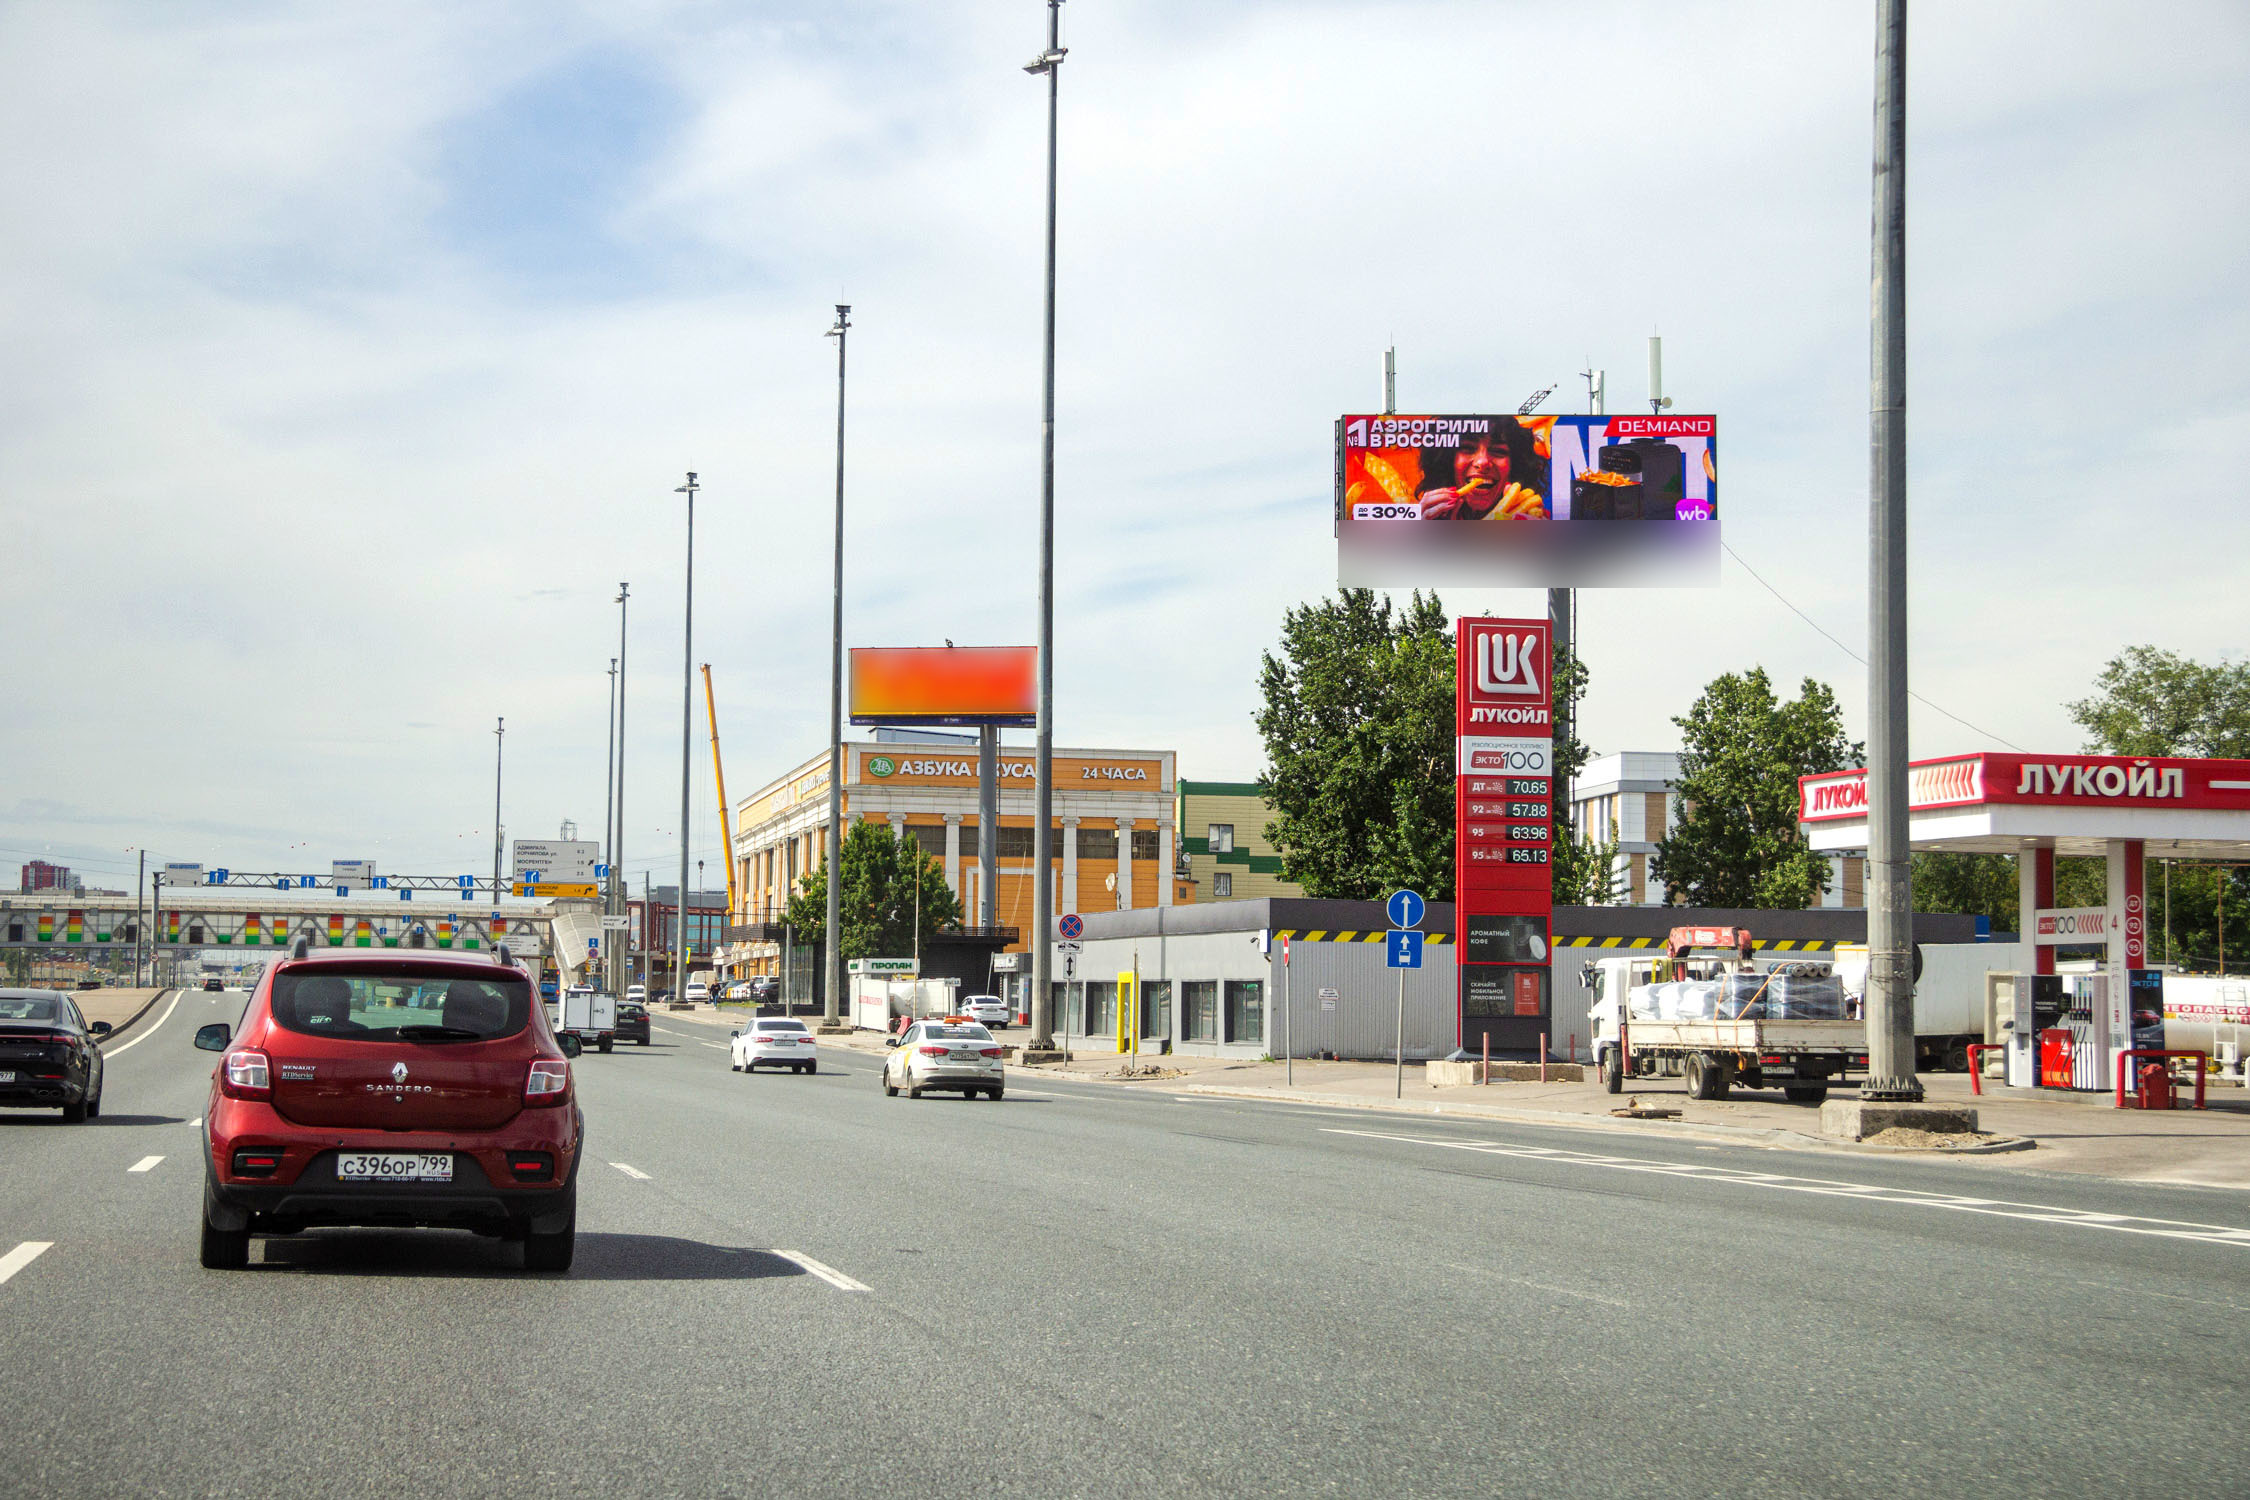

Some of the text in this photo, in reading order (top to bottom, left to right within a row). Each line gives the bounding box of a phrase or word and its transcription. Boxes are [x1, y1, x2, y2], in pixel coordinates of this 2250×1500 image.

[1371, 419, 1489, 433] АЭРОГРИЛИ
[1370, 433, 1460, 448] В РОССИИ
[1678, 505, 1708, 520] wb
[1469, 706, 1548, 725] ЛУКОЙЛ
[899, 760, 972, 777] АЗБУКА
[976, 762, 1036, 778] УСА
[1082, 767, 1147, 780] 24 ЧАСА
[2016, 760, 2184, 798] ЛУКОЙЛ
[1472, 782, 1486, 792] ДТ
[1512, 782, 1547, 794] 70.65
[1812, 775, 1869, 811] ЛУКОЙ
[1472, 804, 1484, 813] 92
[1512, 805, 1547, 817] 57.88
[1472, 827, 1547, 840] 95 63.96
[1472, 851, 1484, 859] 95
[1512, 850, 1547, 863] 65.13
[2111, 914, 2118, 931] 4
[2129, 921, 2139, 930] 92
[1470, 929, 1510, 937] АРОМАТНЫЙ
[2129, 943, 2140, 951] 95
[871, 962, 912, 970] ПРОПАН
[366, 1084, 432, 1093] SANDERO
[343, 1156, 448, 1175] С396ОР 799
